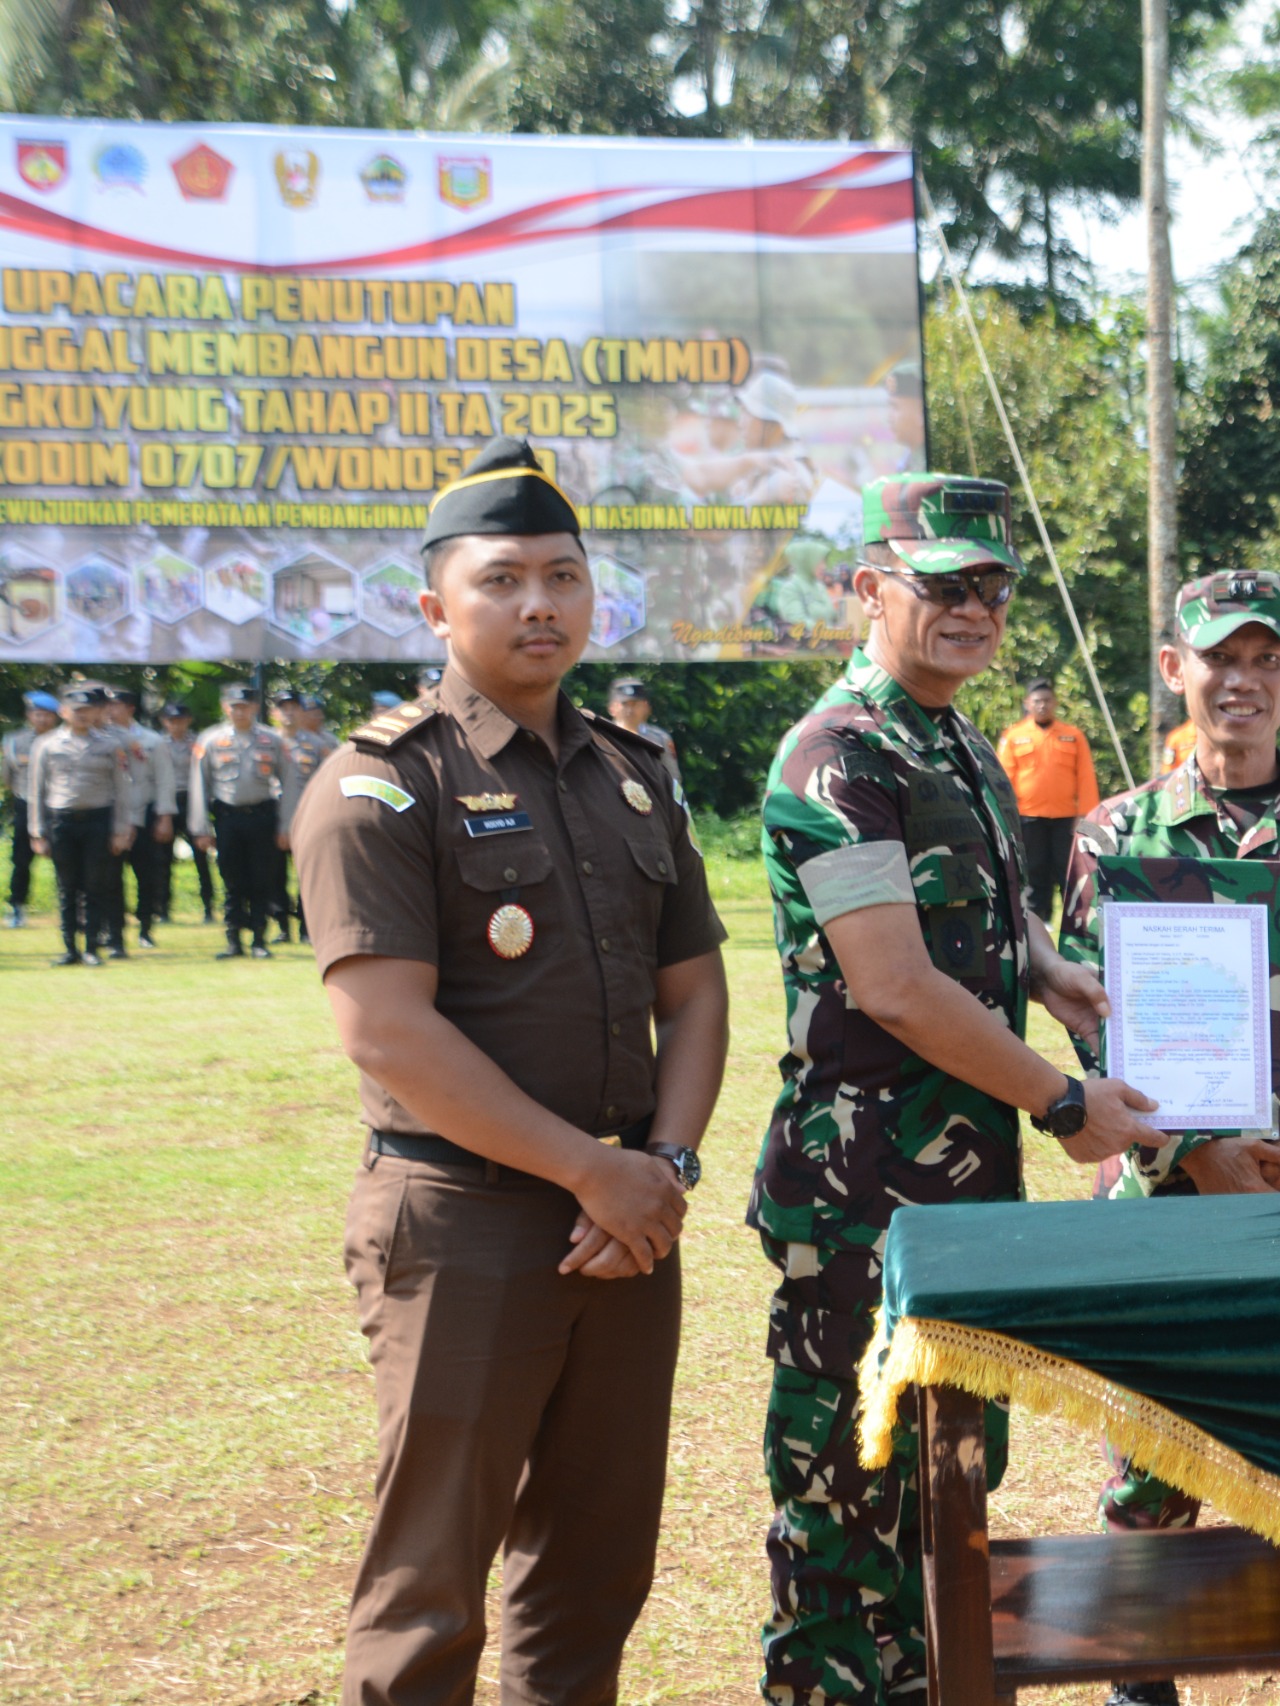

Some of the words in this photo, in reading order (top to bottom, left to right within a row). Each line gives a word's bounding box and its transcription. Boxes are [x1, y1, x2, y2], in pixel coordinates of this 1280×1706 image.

[3, 268, 234, 320] UPACARA
[241, 277, 515, 327] PENUTUPAN
[148, 331, 447, 381] MEMBANGUN
[457, 337, 573, 382] DESA
[580, 336, 752, 386] (TMMD)
[239, 388, 391, 435] TAHAP
[400, 391, 431, 436] II
[438, 392, 495, 436] TA
[502, 393, 617, 437] 2025
[0, 440, 130, 487] ODIM
[135, 501, 271, 527] PEMERATAAN
[275, 503, 429, 529] PEMBANGUNAN
[594, 504, 690, 530] NASIONAL
[1142, 925, 1172, 934] NASKAH
[1173, 925, 1198, 934] SERAH
[1199, 925, 1226, 934] TERIMA
